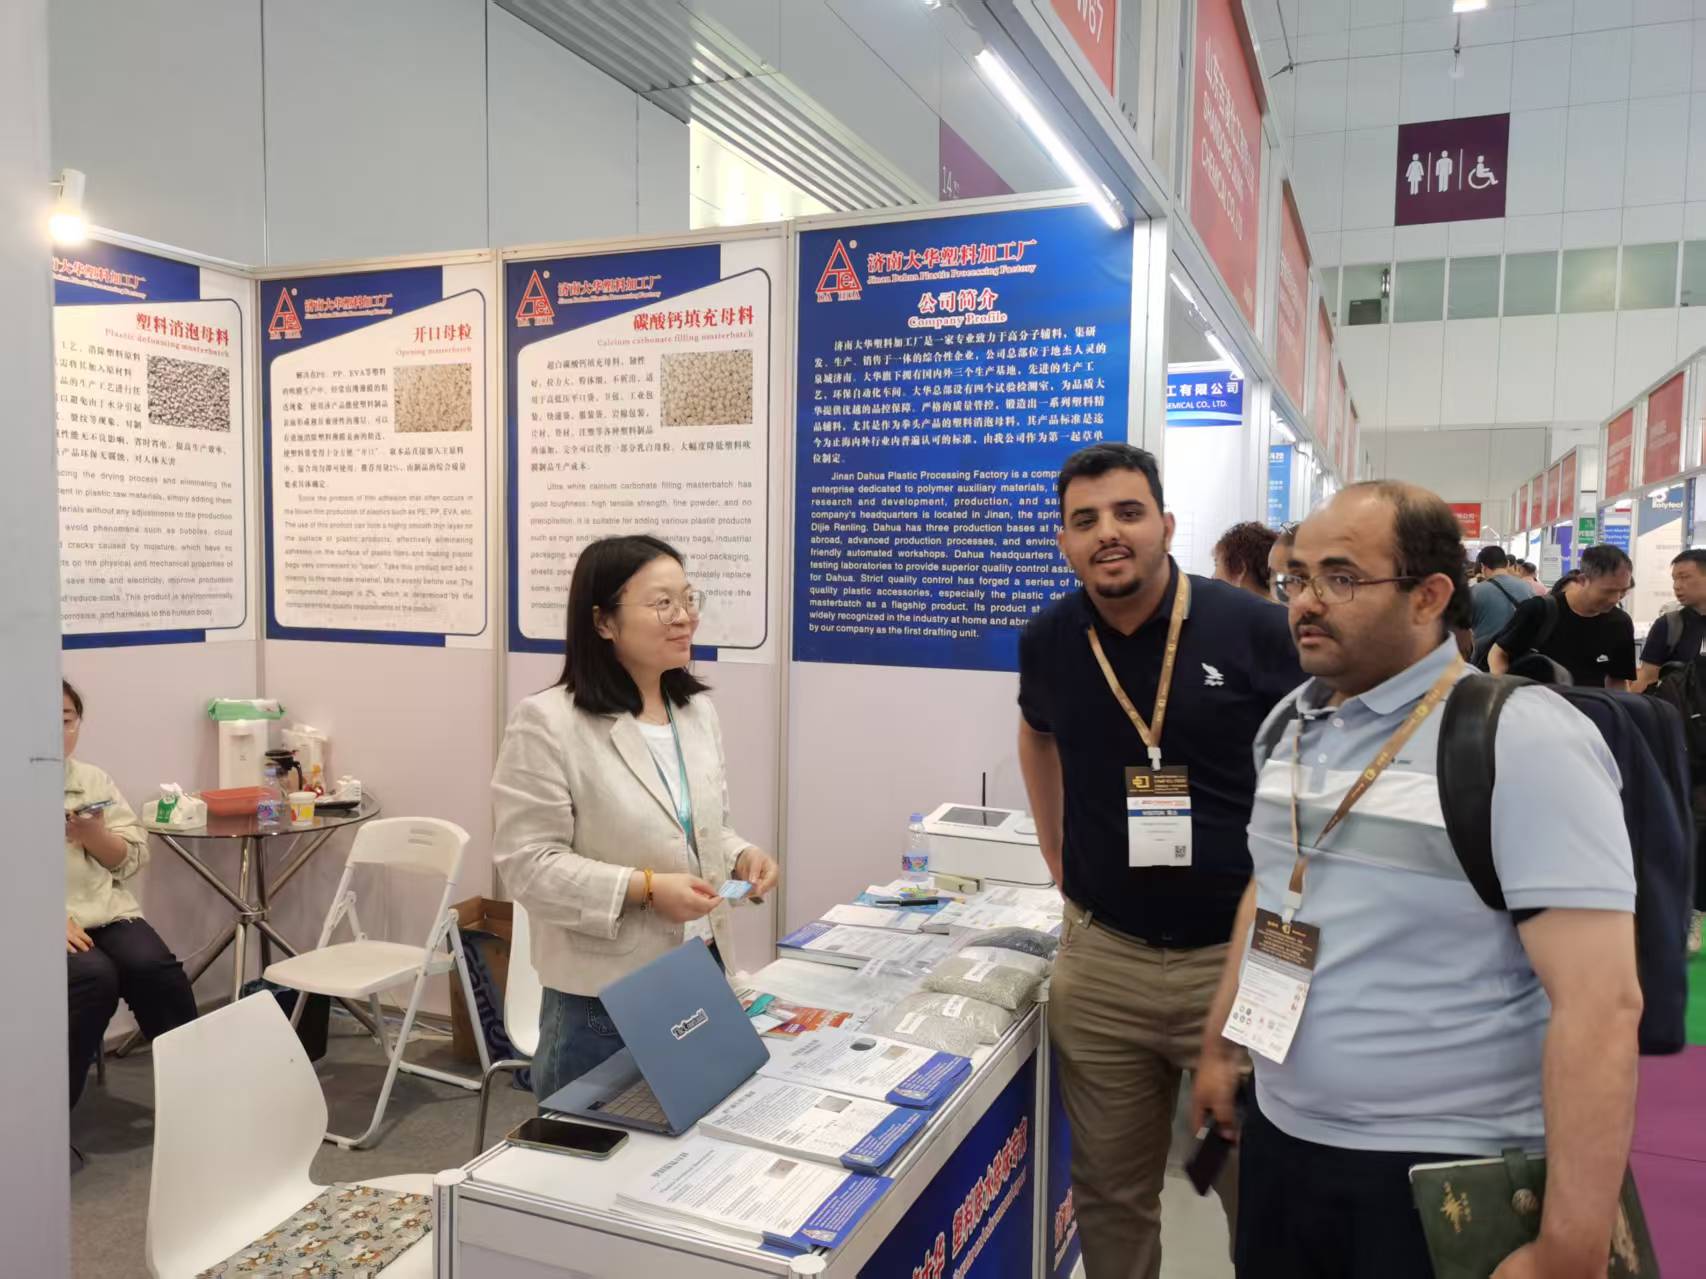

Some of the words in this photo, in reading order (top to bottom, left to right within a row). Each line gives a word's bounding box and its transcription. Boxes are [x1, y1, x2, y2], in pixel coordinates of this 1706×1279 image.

[867, 239, 1038, 273] 济南大华塑料加工厂
[918, 288, 998, 313] 公司简介
[633, 305, 754, 331] 碳酸钙填充母料
[909, 314, 964, 329] Company
[965, 311, 1007, 325] Profile
[136, 312, 229, 346] 塑料消泡母料
[414, 323, 472, 343] 开口母粒
[1167, 382, 1238, 396] 工有限公司
[831, 472, 855, 480] Jinan
[857, 471, 885, 480] Dahua
[887, 471, 918, 480] Plastic
[920, 470, 971, 481] Processing
[973, 469, 1009, 481] Factory
[1011, 470, 1019, 478] is
[812, 485, 854, 495] enterprise
[858, 484, 901, 493] dedicated
[904, 485, 914, 493] to
[917, 483, 954, 495] polymer
[957, 483, 996, 494] auxiliary
[812, 498, 852, 506] research
[858, 497, 876, 506] and
[1019, 496, 1038, 505] and
[811, 510, 856, 520] company's
[860, 510, 918, 520] headquarters
[922, 510, 930, 519] is
[934, 510, 968, 519] located
[972, 510, 980, 519] in
[1018, 510, 1033, 519] the
[873, 523, 902, 532] Dahua
[905, 523, 922, 532] has
[926, 523, 949, 532] three
[953, 523, 1002, 534] production
[1006, 523, 1035, 532] bases
[1040, 524, 1049, 532] at
[848, 536, 890, 544] advanced
[894, 536, 942, 546] production
[1002, 537, 1021, 546] and
[810, 548, 842, 558] friendly
[846, 549, 893, 557] automated
[954, 549, 984, 559] Dahua
[990, 550, 1053, 561] headquarters
[810, 560, 839, 571] testing
[841, 561, 892, 570] laboratories
[894, 562, 903, 570] to
[905, 561, 939, 573] provide
[941, 563, 980, 573] superior
[982, 563, 1013, 574] quality
[1015, 564, 1049, 573] control
[810, 573, 822, 582] for
[860, 574, 883, 583] Strict
[888, 574, 917, 585] quality
[922, 575, 953, 584] control
[958, 576, 974, 585] has
[979, 576, 1010, 588] forged
[1014, 578, 1020, 586] a
[1025, 577, 1055, 587] series
[1059, 578, 1070, 587] of
[809, 585, 838, 596] quality
[843, 586, 871, 596] plastic
[938, 588, 985, 600] especially
[991, 589, 1006, 599] the
[1012, 590, 1044, 601] plastic
[809, 598, 862, 608] masterbatch
[891, 600, 927, 612] flagship
[974, 602, 985, 611] Its
[990, 603, 1026, 614] product
[809, 610, 836, 621] widely
[837, 611, 885, 623] recognized
[886, 613, 895, 621] in
[896, 613, 911, 622] the
[913, 614, 949, 625] industry
[951, 616, 960, 624] at
[962, 615, 987, 625] home
[989, 616, 1007, 625] and
[809, 623, 819, 633] by
[820, 624, 835, 632] our
[836, 625, 874, 635] company
[876, 626, 887, 634] as
[888, 625, 902, 634] the
[904, 626, 921, 635] first
[923, 626, 957, 639] drafting
